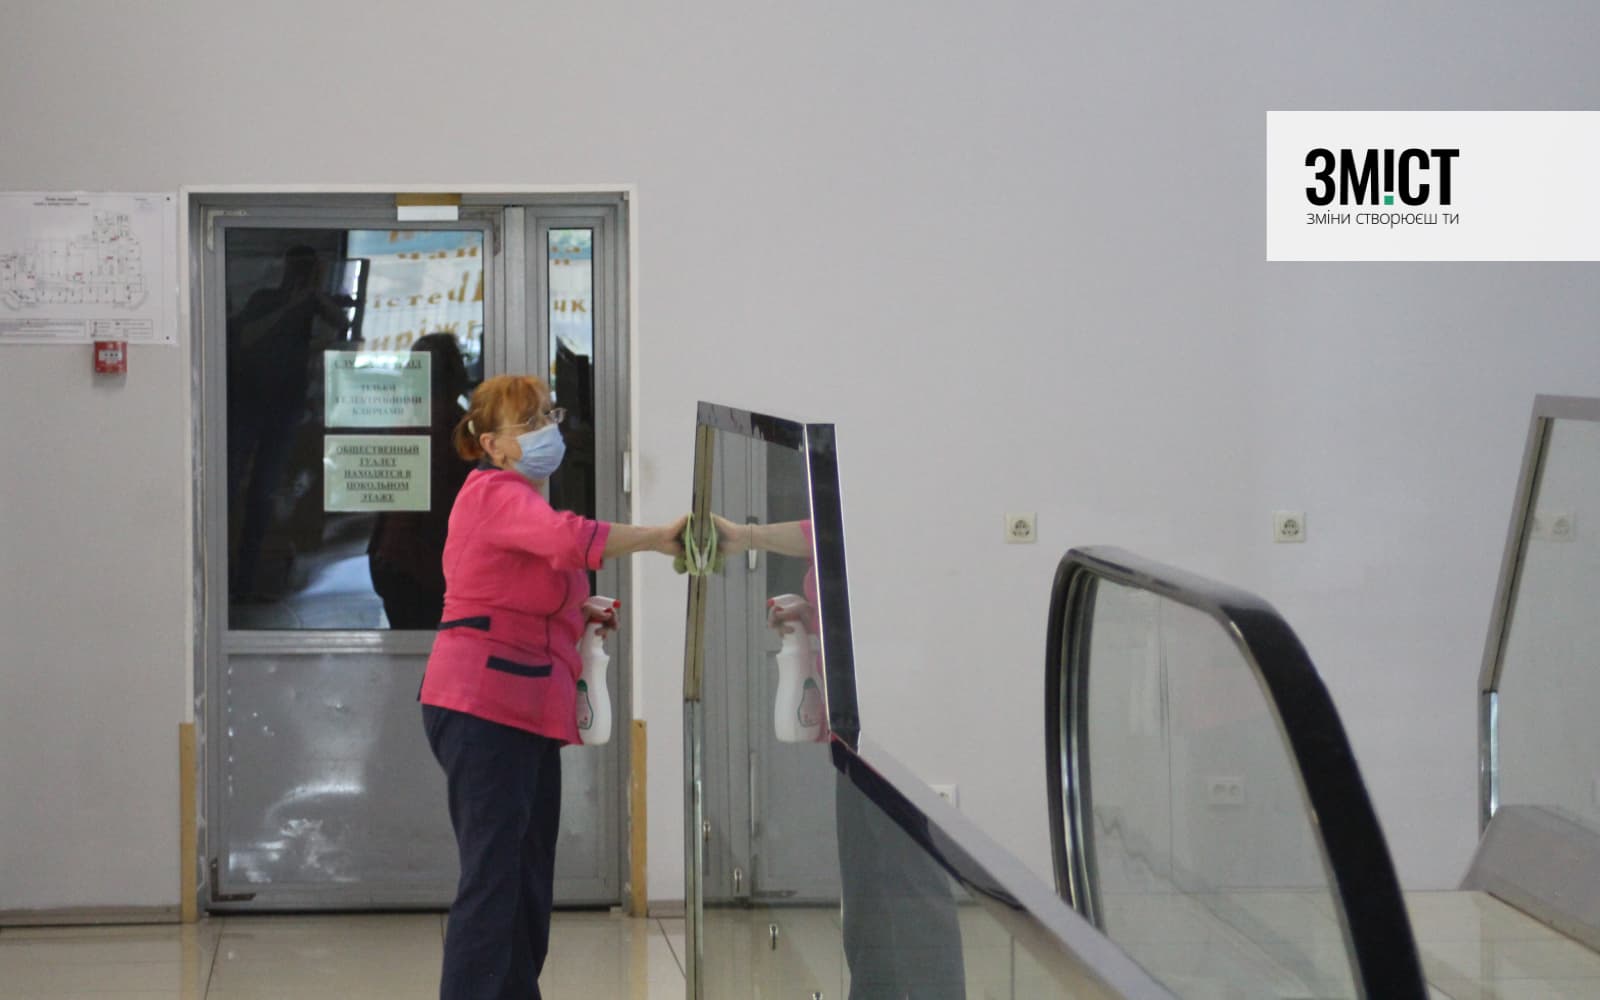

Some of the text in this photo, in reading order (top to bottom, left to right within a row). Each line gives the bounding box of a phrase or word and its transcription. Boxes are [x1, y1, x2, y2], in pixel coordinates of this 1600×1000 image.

[336, 445, 420, 456] ОБЩЕСТВЕННЫЙ
[360, 457, 397, 468] ТУАЛЕТ
[346, 481, 409, 492] ЦОКОЛЬНОМ
[360, 493, 396, 503] ЭТАЖЕ
